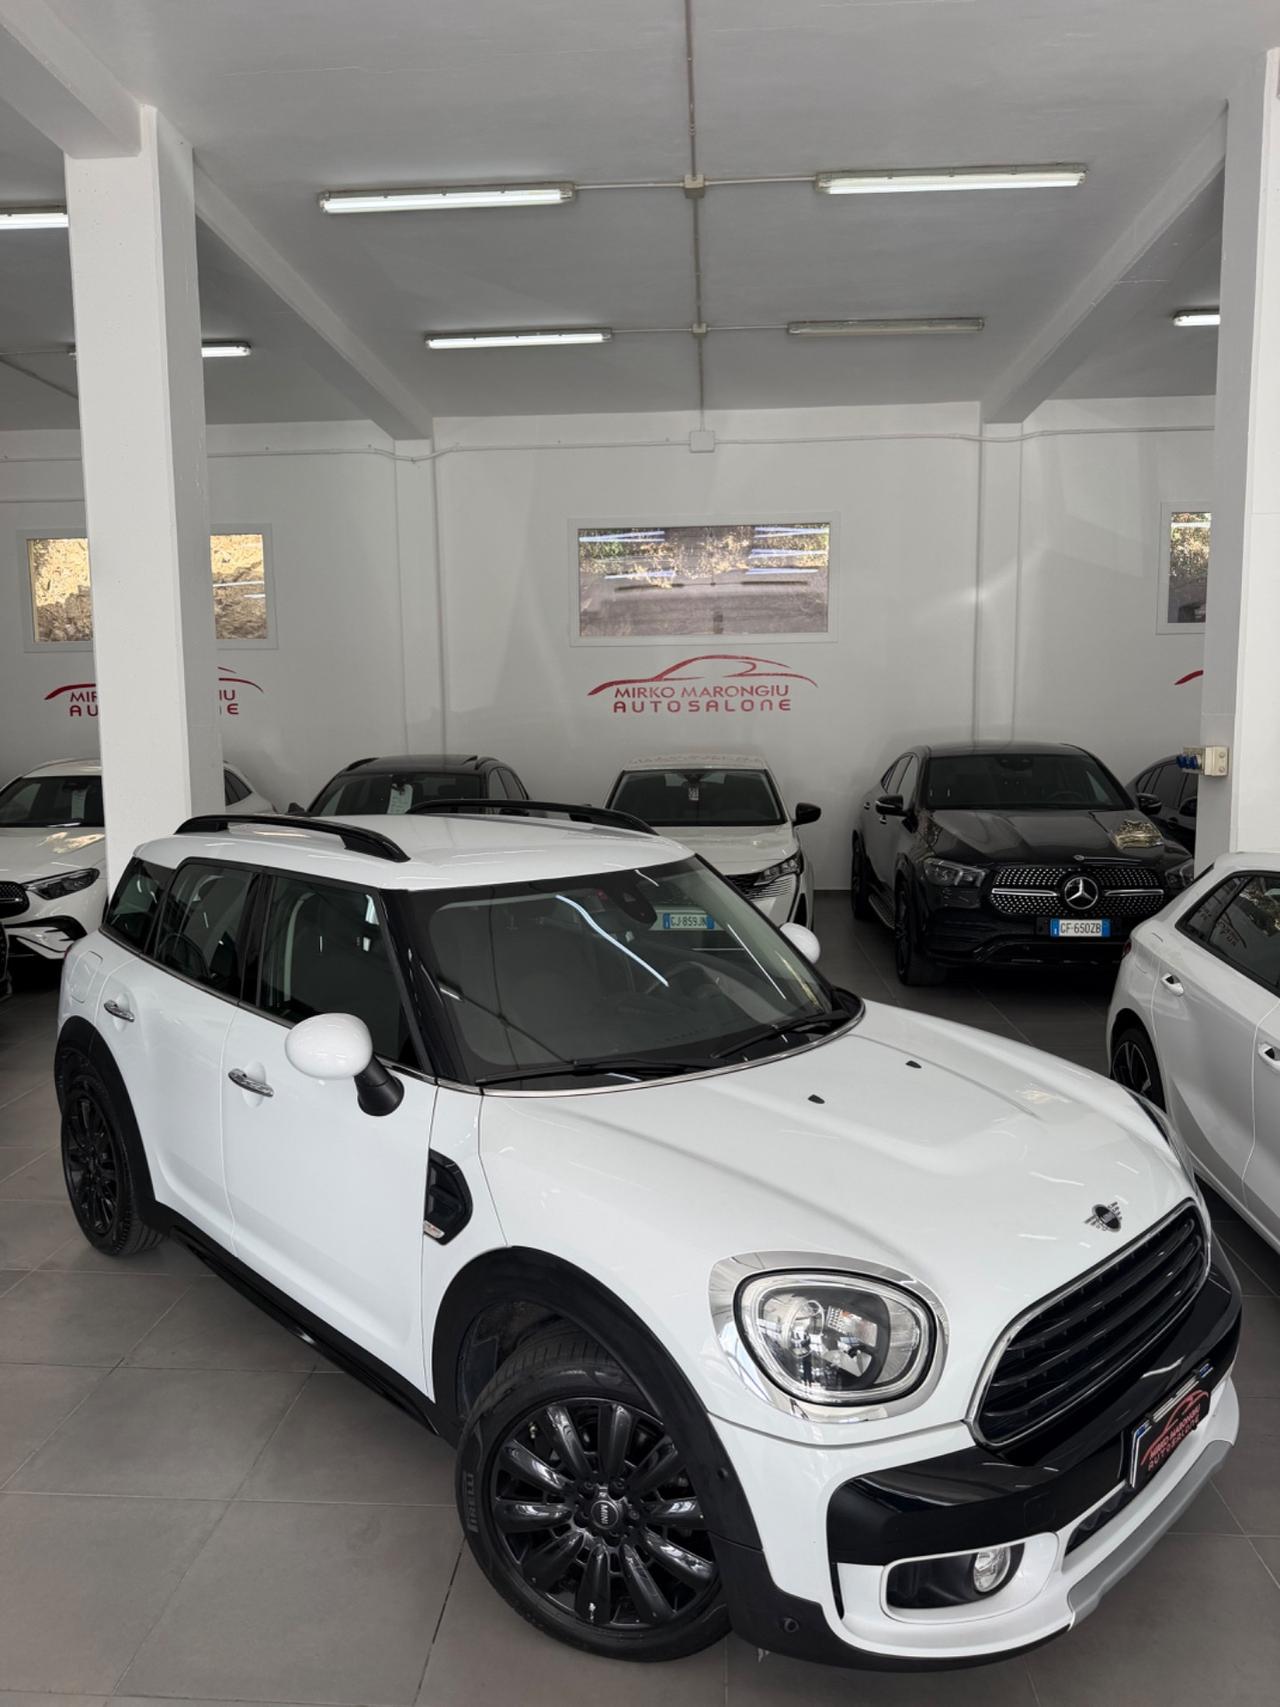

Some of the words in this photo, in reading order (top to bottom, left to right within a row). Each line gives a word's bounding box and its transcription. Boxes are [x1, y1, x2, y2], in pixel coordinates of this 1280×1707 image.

[614, 686, 675, 699] MIRKO
[681, 684, 789, 699] MARONGIU
[613, 699, 791, 713] AUTOSALONE
[600, 1503, 608, 1525] MINI
